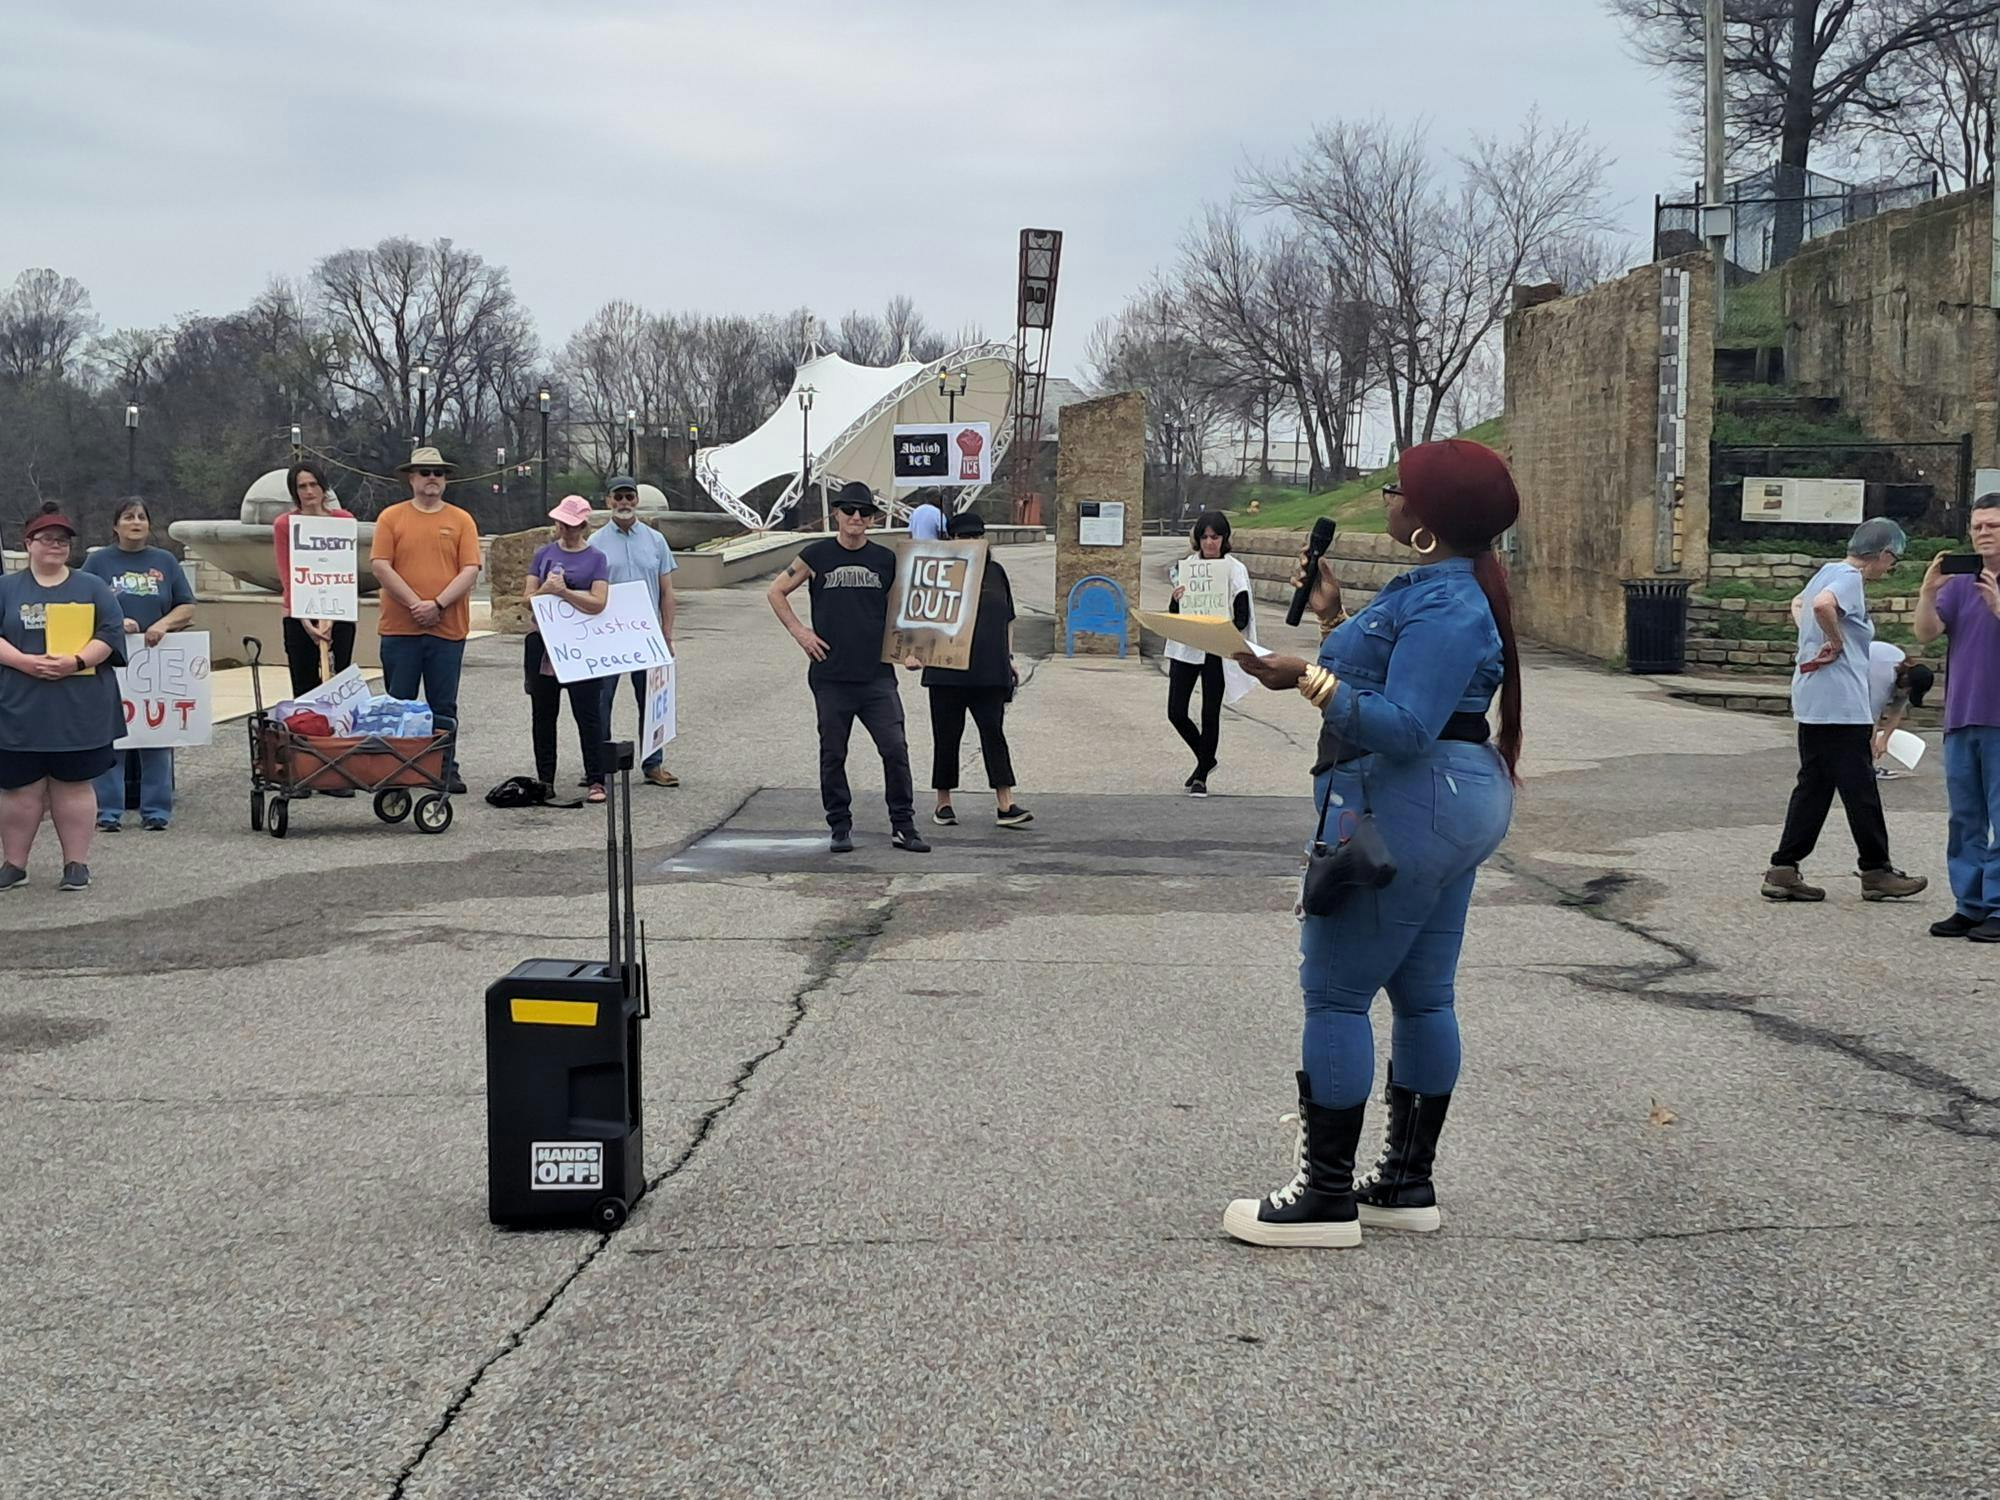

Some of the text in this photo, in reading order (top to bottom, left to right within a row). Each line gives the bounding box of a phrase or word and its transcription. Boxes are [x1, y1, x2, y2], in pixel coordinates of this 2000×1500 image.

[900, 442, 940, 456] Abolish
[908, 455, 931, 466] ICE
[963, 461, 978, 474] ICE
[295, 567, 355, 585] JUSTICE
[914, 560, 954, 588] ICE
[1189, 563, 1213, 578] ICE
[1189, 579, 1213, 592] OUT
[304, 598, 346, 615] ALL
[908, 590, 961, 620] OUT
[575, 618, 650, 640] Justice
[126, 648, 187, 696] CE
[652, 688, 668, 721] ICE
[538, 1149, 598, 1161] HANDS
[538, 1162, 598, 1183] OFF!
